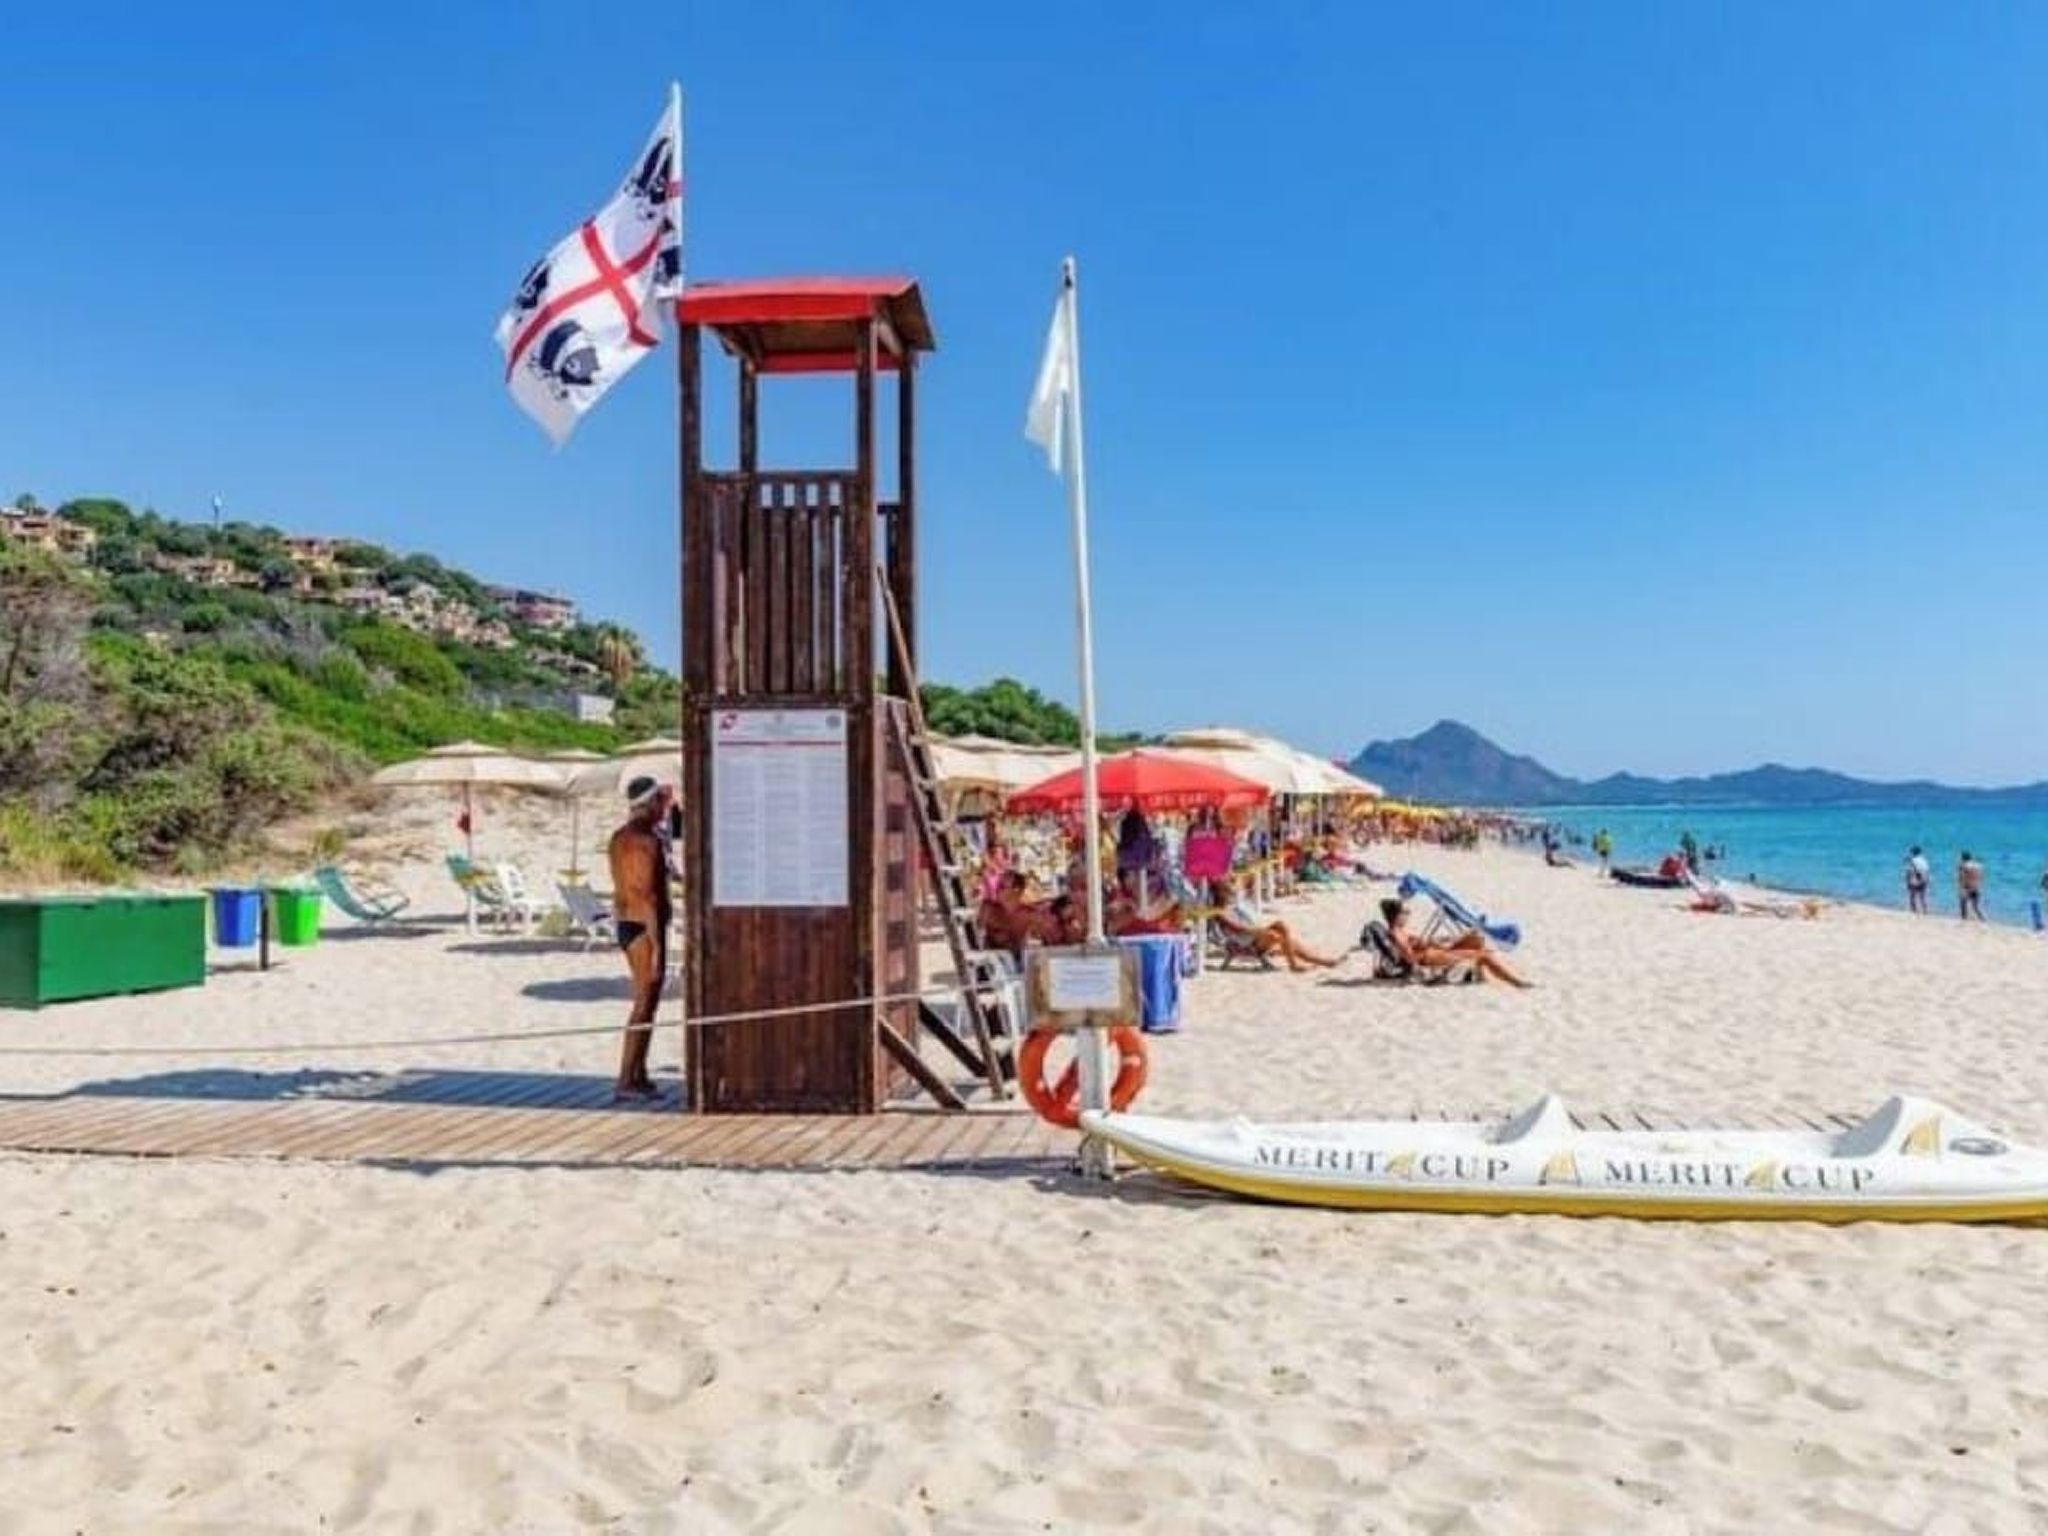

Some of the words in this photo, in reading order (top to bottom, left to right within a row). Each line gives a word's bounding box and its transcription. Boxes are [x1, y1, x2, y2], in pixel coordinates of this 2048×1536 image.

[1254, 1146, 1381, 1173] MERIT
[1422, 1154, 1509, 1181] CUP
[1605, 1161, 1738, 1187] MERIT
[1782, 1165, 1874, 1191] CUP
